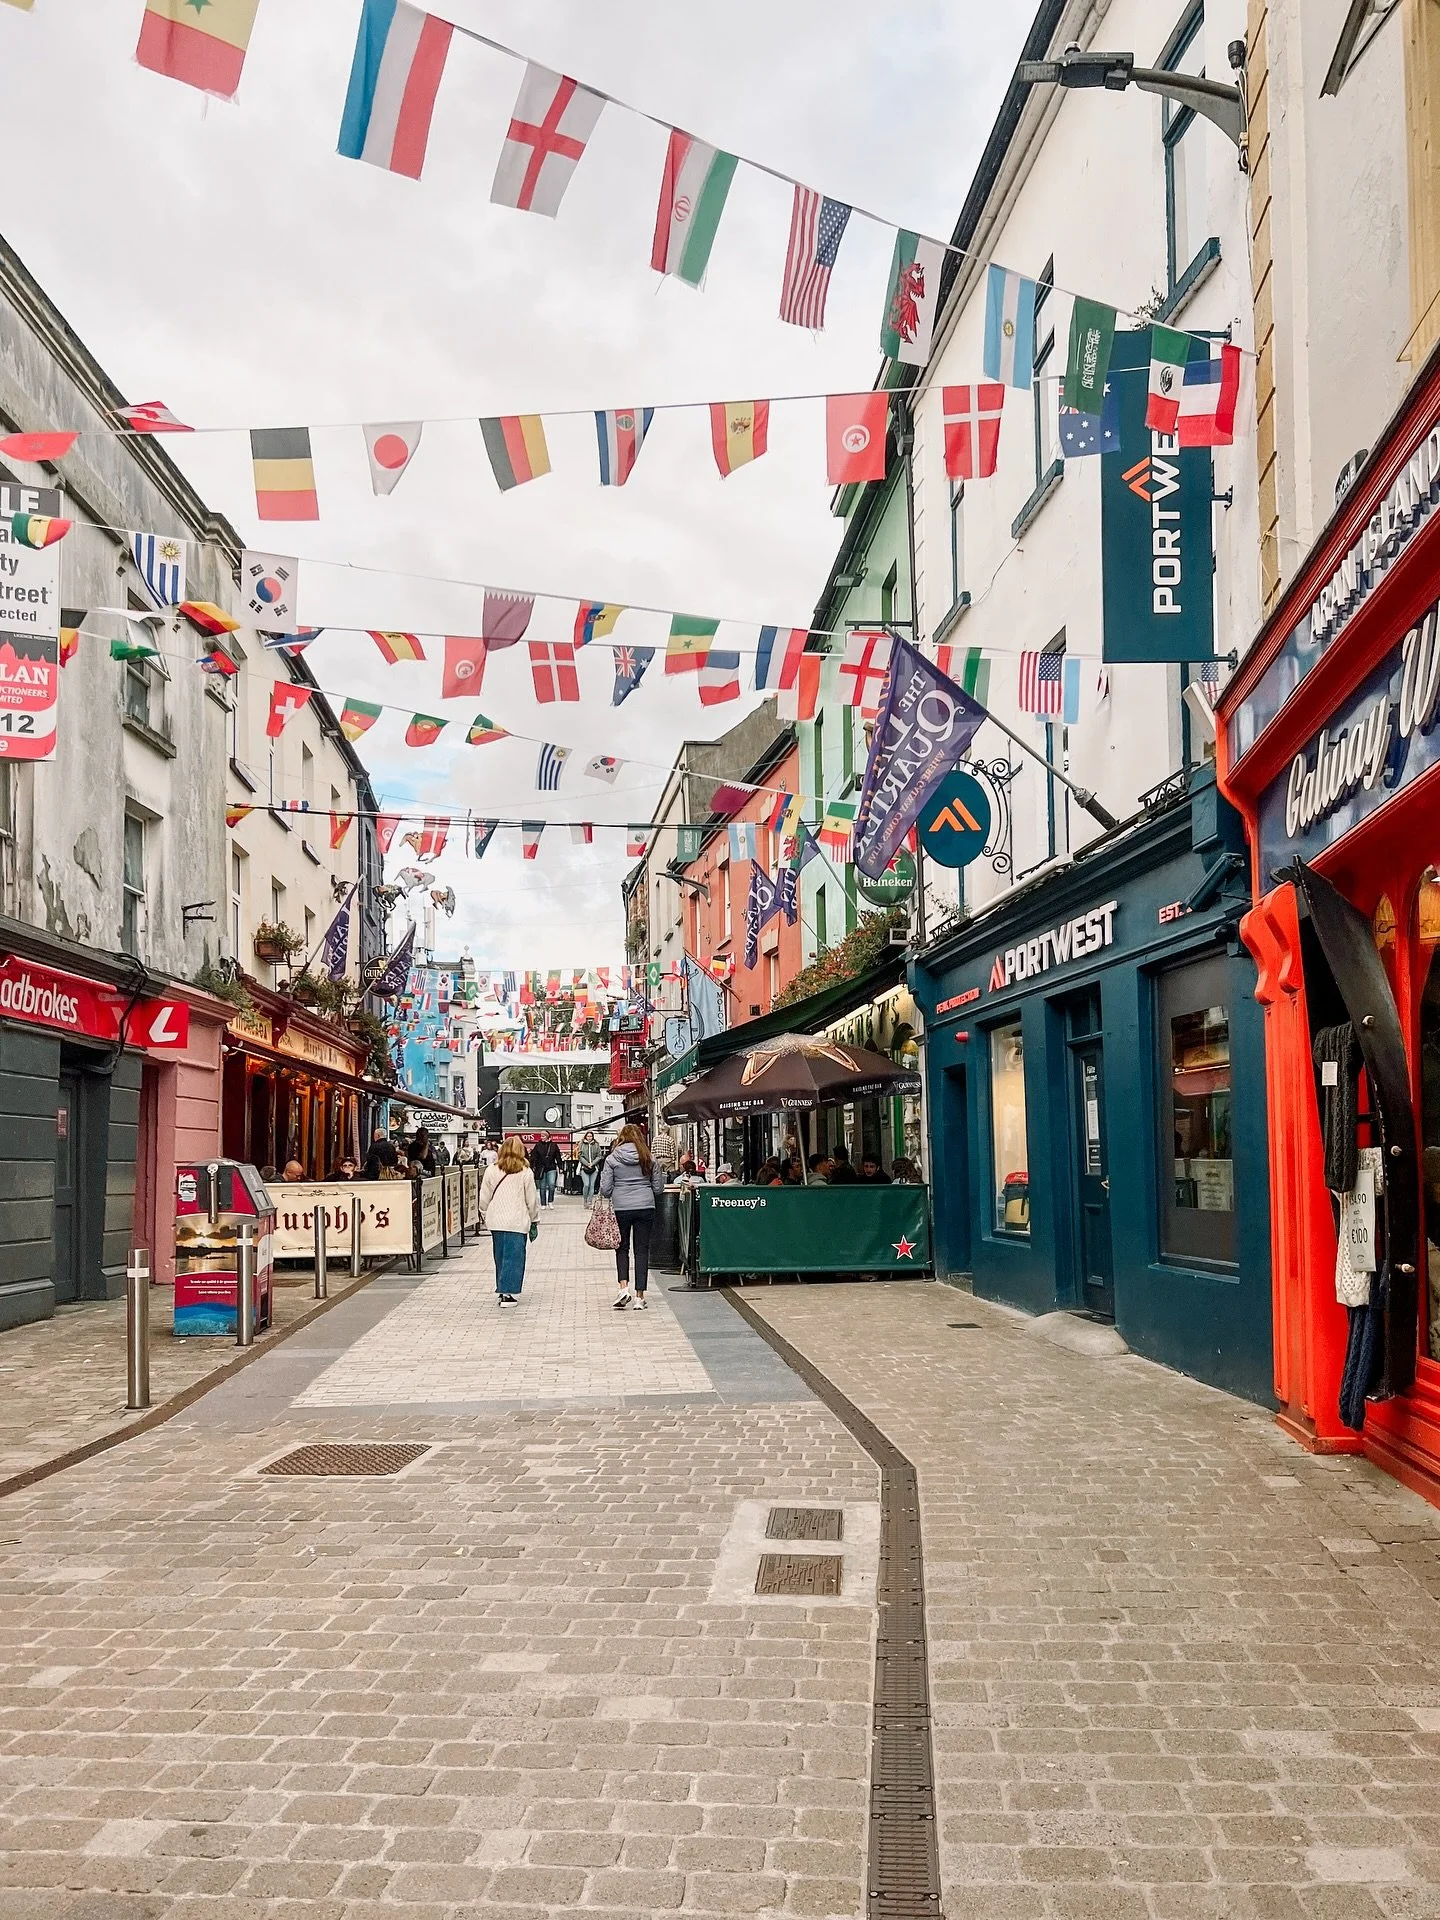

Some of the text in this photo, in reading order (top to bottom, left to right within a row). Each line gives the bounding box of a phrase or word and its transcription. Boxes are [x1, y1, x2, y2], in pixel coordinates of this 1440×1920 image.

[1151, 430, 1182, 614] PORTWE
[1310, 550, 1357, 644] ARAN
[0, 686, 48, 699] CTIONEERS
[1, 713, 34, 734] 12
[1286, 696, 1391, 838] Galway
[863, 877, 913, 888] Heineken
[1005, 900, 1118, 986] PORTWEST
[0, 973, 79, 1024] adbrokes
[720, 1101, 741, 1110] RAISING
[787, 1098, 813, 1107] GUINNESS
[711, 1196, 767, 1209] Freeney's
[1351, 1227, 1369, 1245] €100
